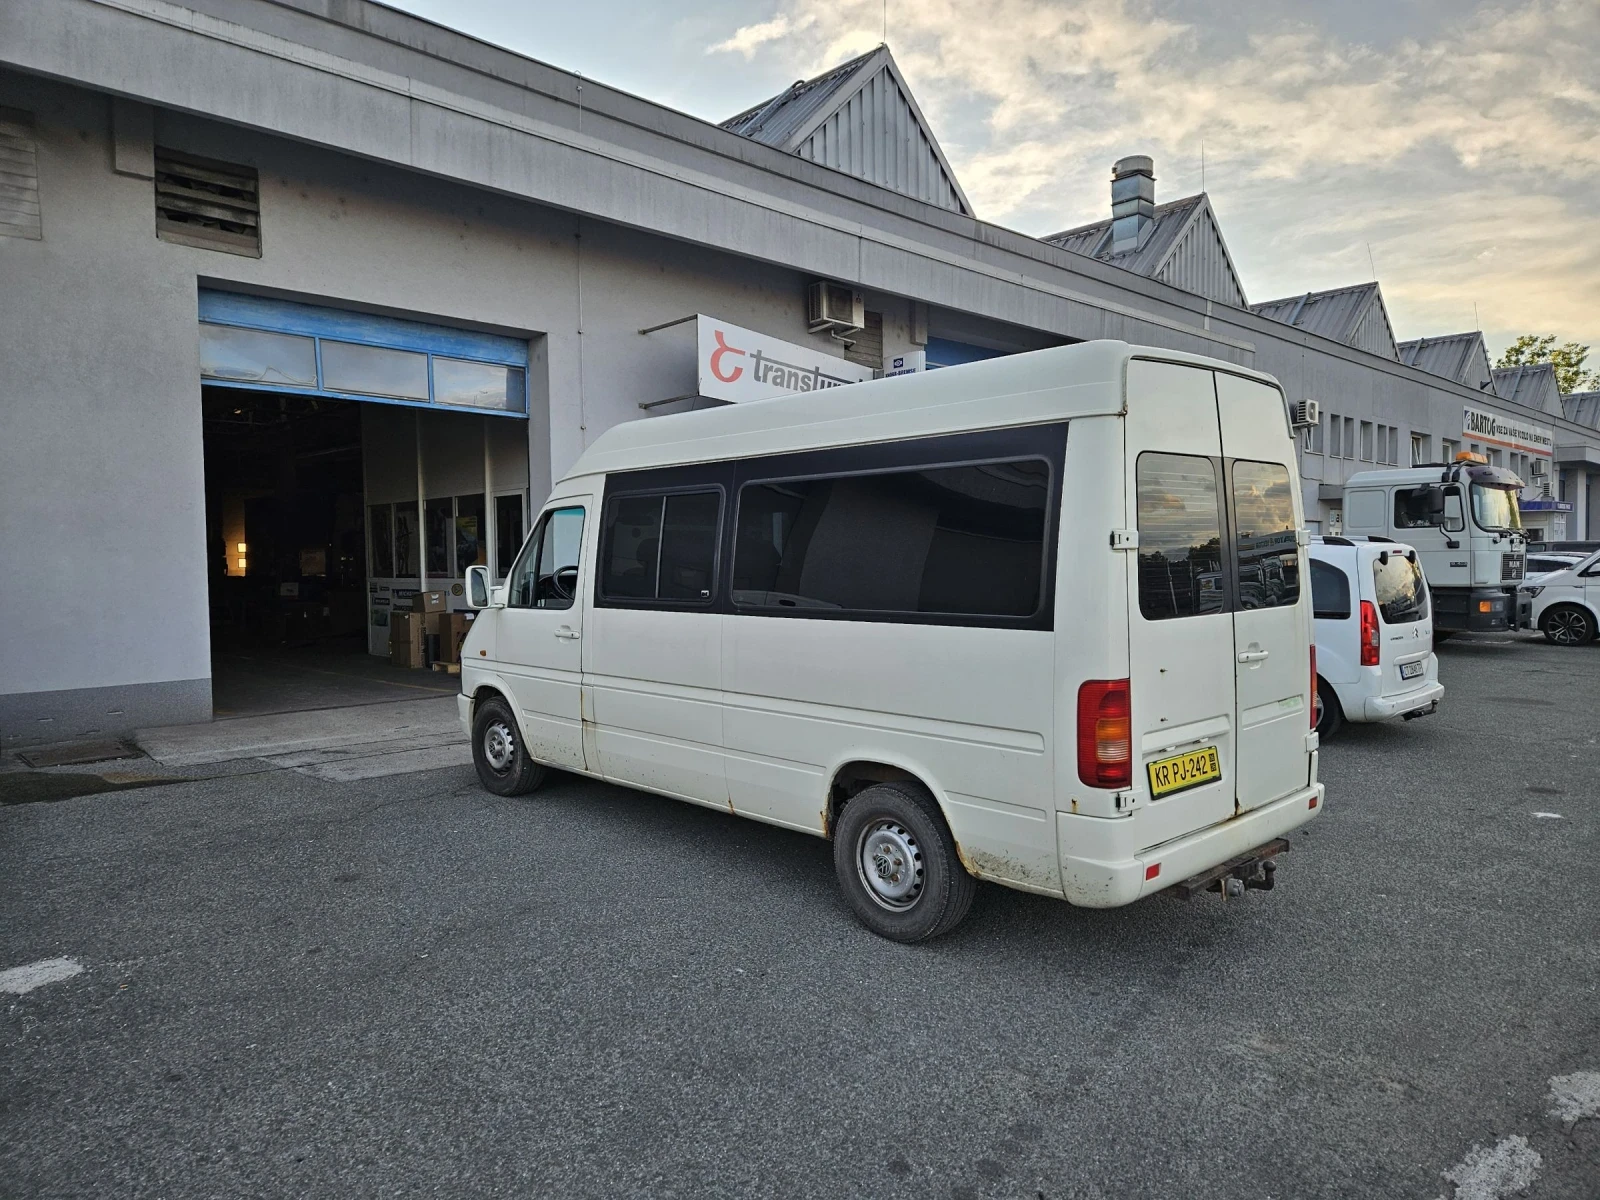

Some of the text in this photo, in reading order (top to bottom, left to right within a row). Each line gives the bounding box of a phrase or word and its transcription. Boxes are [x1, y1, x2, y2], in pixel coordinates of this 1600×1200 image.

[749, 348, 863, 393] transtu
[1470, 411, 1496, 436] BARTOG
[1508, 560, 1520, 568] MAN
[1154, 765, 1170, 788] KR
[1172, 755, 1208, 783] PJ-242
